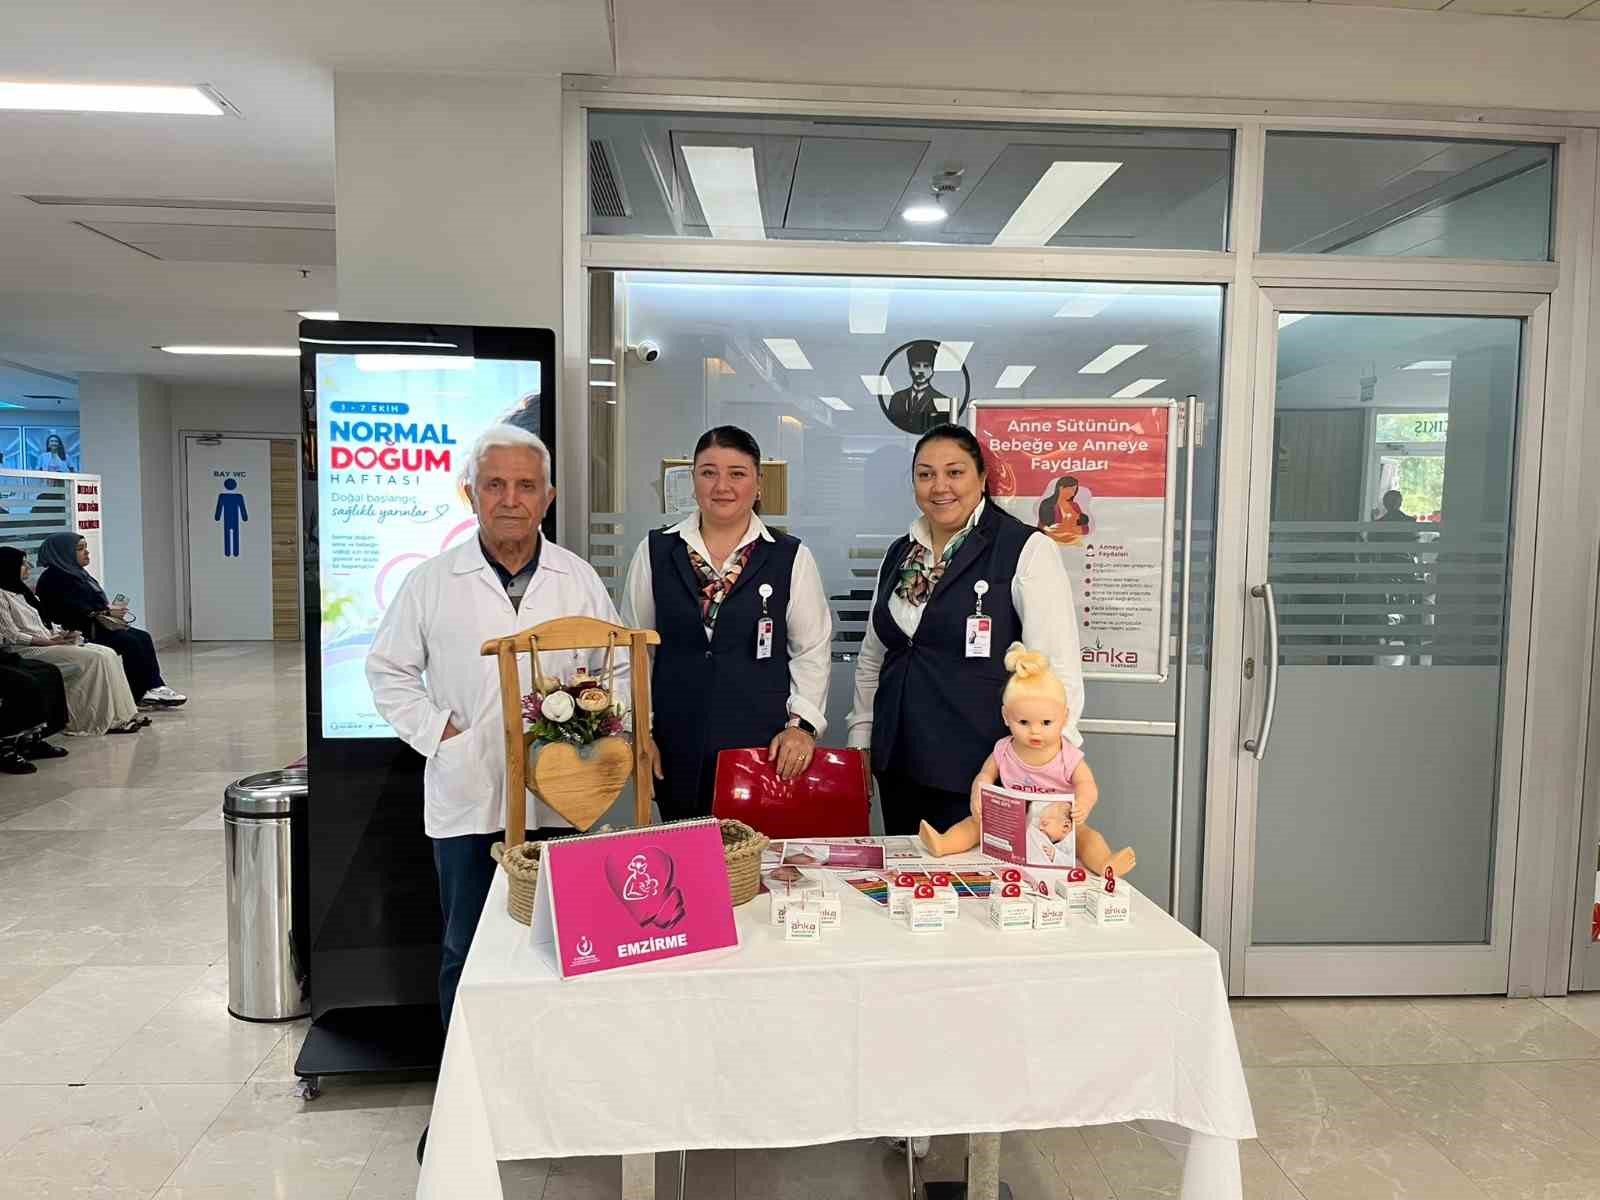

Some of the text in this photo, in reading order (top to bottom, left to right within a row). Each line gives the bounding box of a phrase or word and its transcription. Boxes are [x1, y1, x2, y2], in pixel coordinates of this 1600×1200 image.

[330, 420, 456, 444] NORMAL
[1007, 418, 1129, 433] Anne Sütünün
[989, 438, 1148, 454] Bebeğe ve Anneye
[331, 440, 451, 472] DOĞUM
[1031, 457, 1109, 474] Faydaları
[213, 470, 231, 478] BAY
[330, 474, 420, 486] HAFTASI
[1082, 648, 1138, 663] anka
[617, 933, 688, 958] EMZİRME
